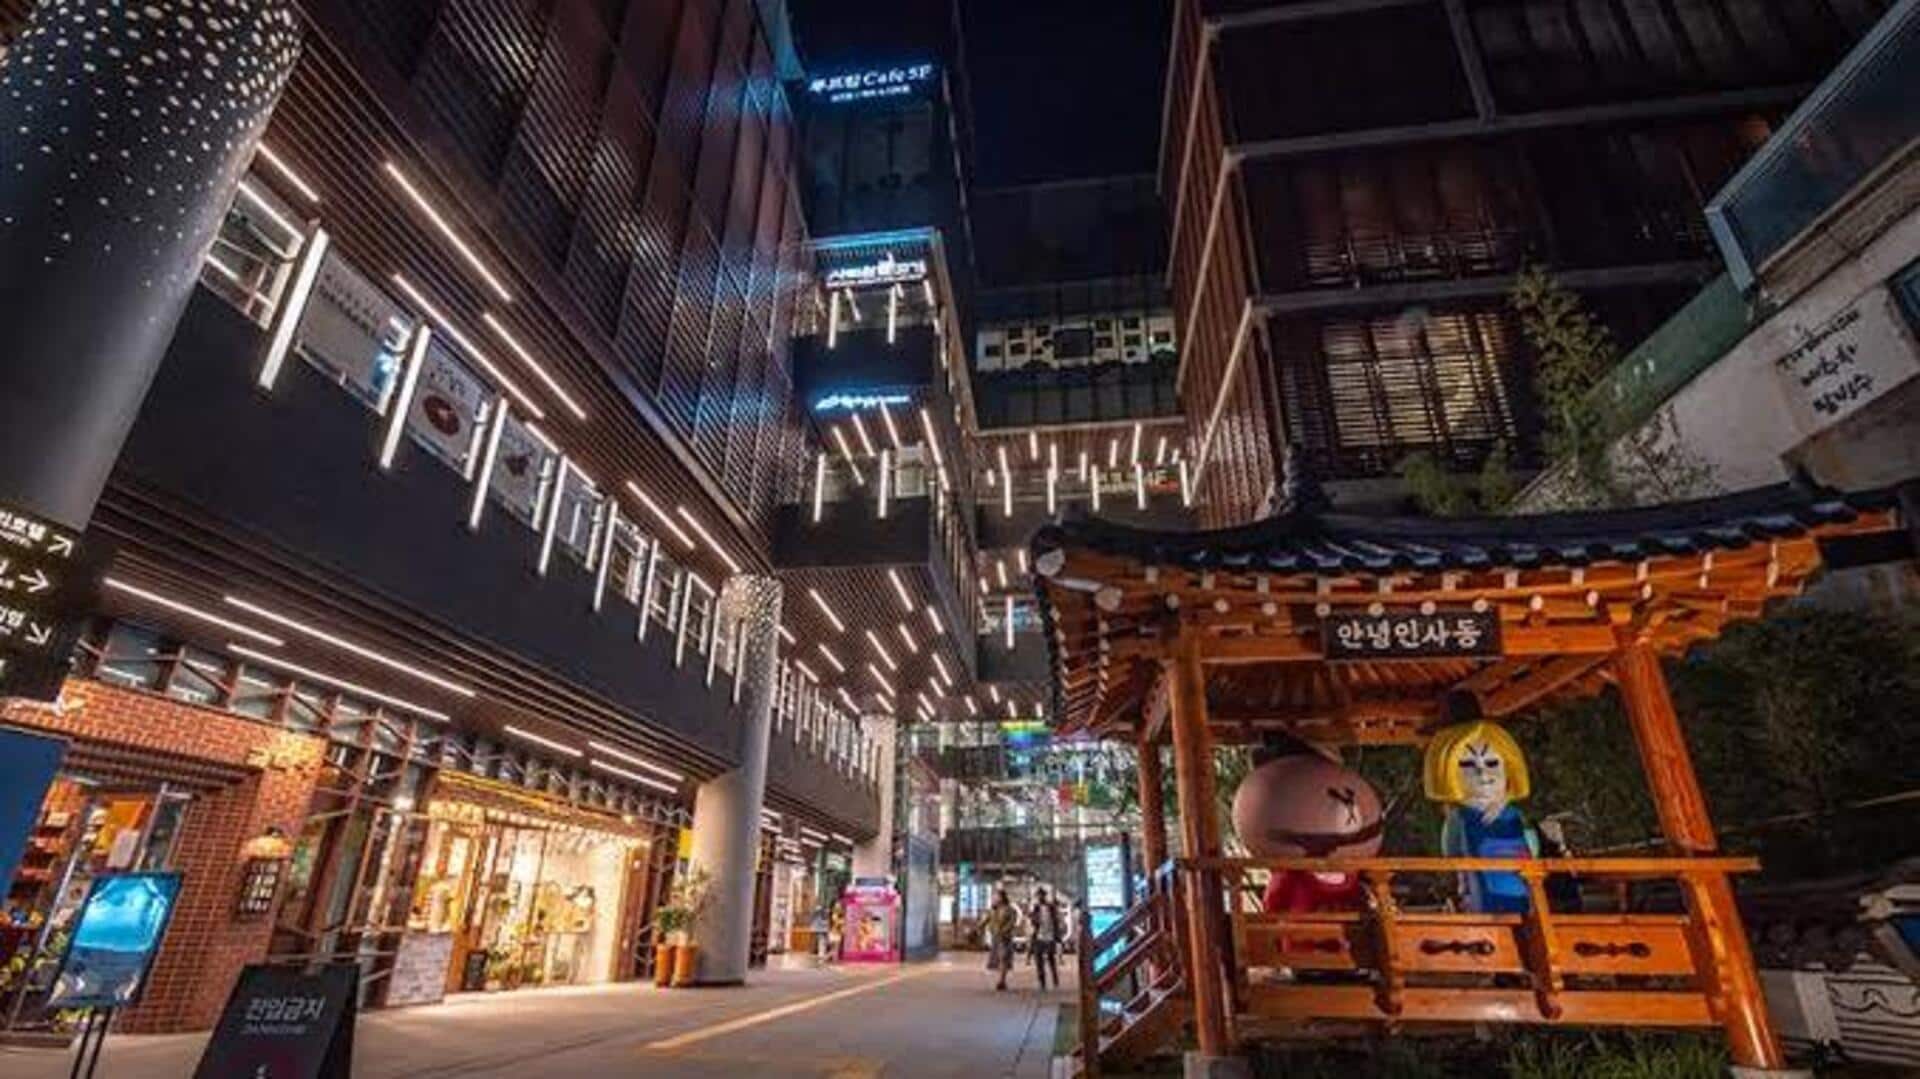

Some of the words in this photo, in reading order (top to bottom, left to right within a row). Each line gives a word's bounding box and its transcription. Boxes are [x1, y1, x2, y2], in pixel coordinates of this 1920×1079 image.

[863, 67, 905, 87] Cafe
[907, 63, 933, 82] 5F
[1337, 618, 1482, 650] 안녕인사동
[246, 995, 327, 1022] 진입금지
